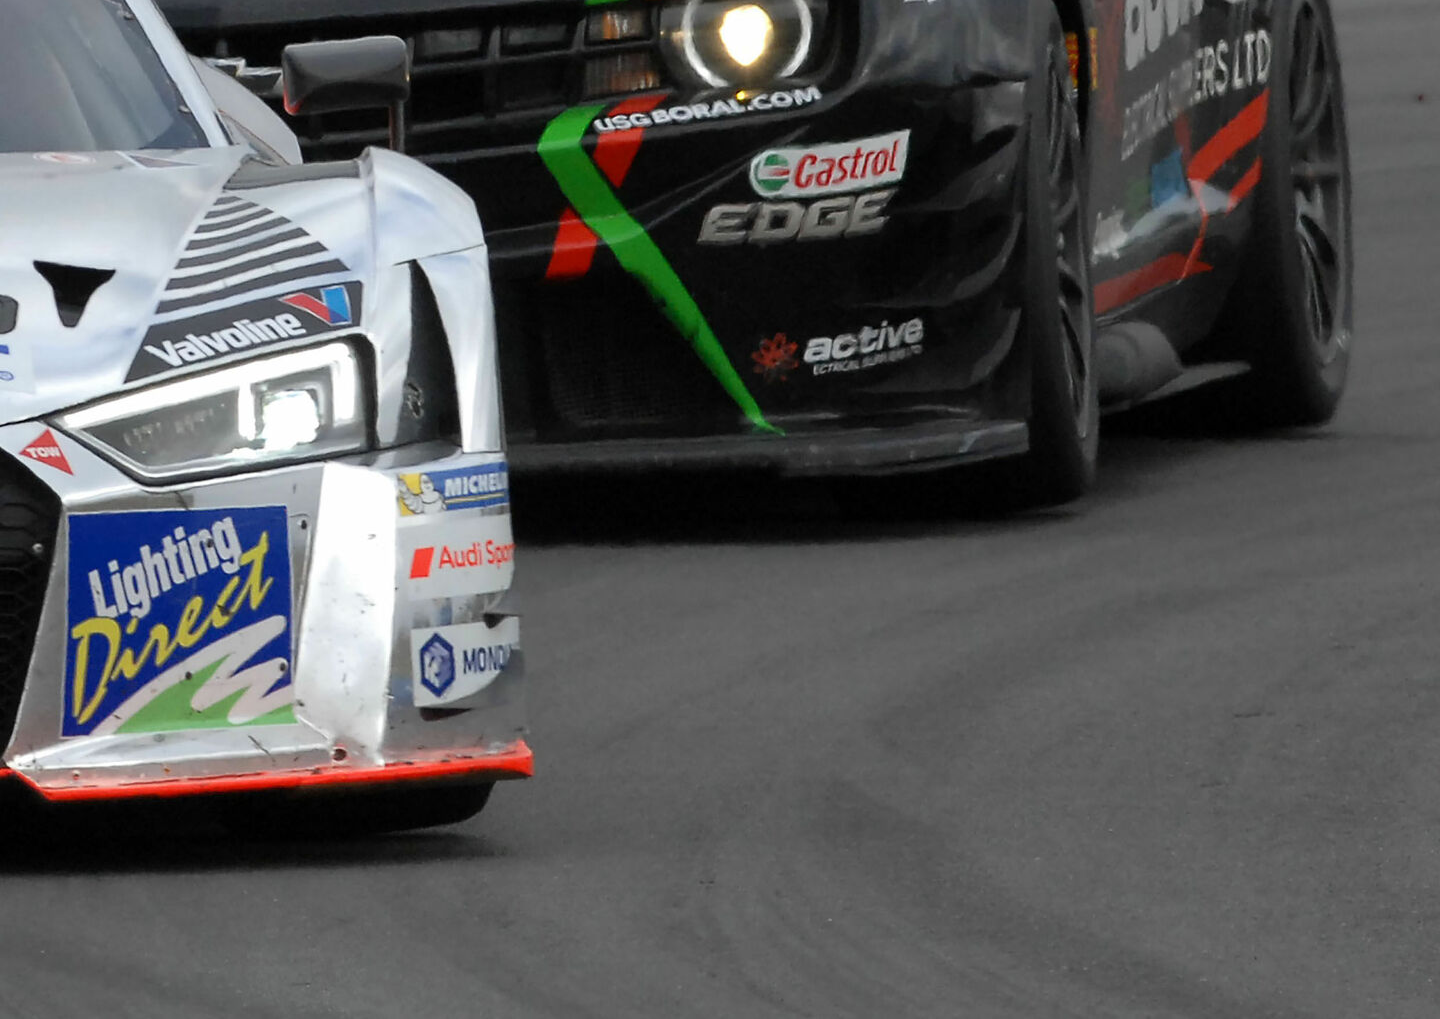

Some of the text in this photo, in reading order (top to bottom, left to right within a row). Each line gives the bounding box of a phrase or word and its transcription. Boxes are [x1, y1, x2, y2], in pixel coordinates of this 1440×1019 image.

[794, 139, 900, 189] Castrol
[696, 189, 897, 246] EDGE
[147, 309, 304, 368] Valvoline
[804, 318, 923, 363] active
[27, 445, 61, 460] TOW
[88, 516, 242, 619] Lighting
[439, 542, 483, 569] Audi
[72, 532, 273, 724] Direct
